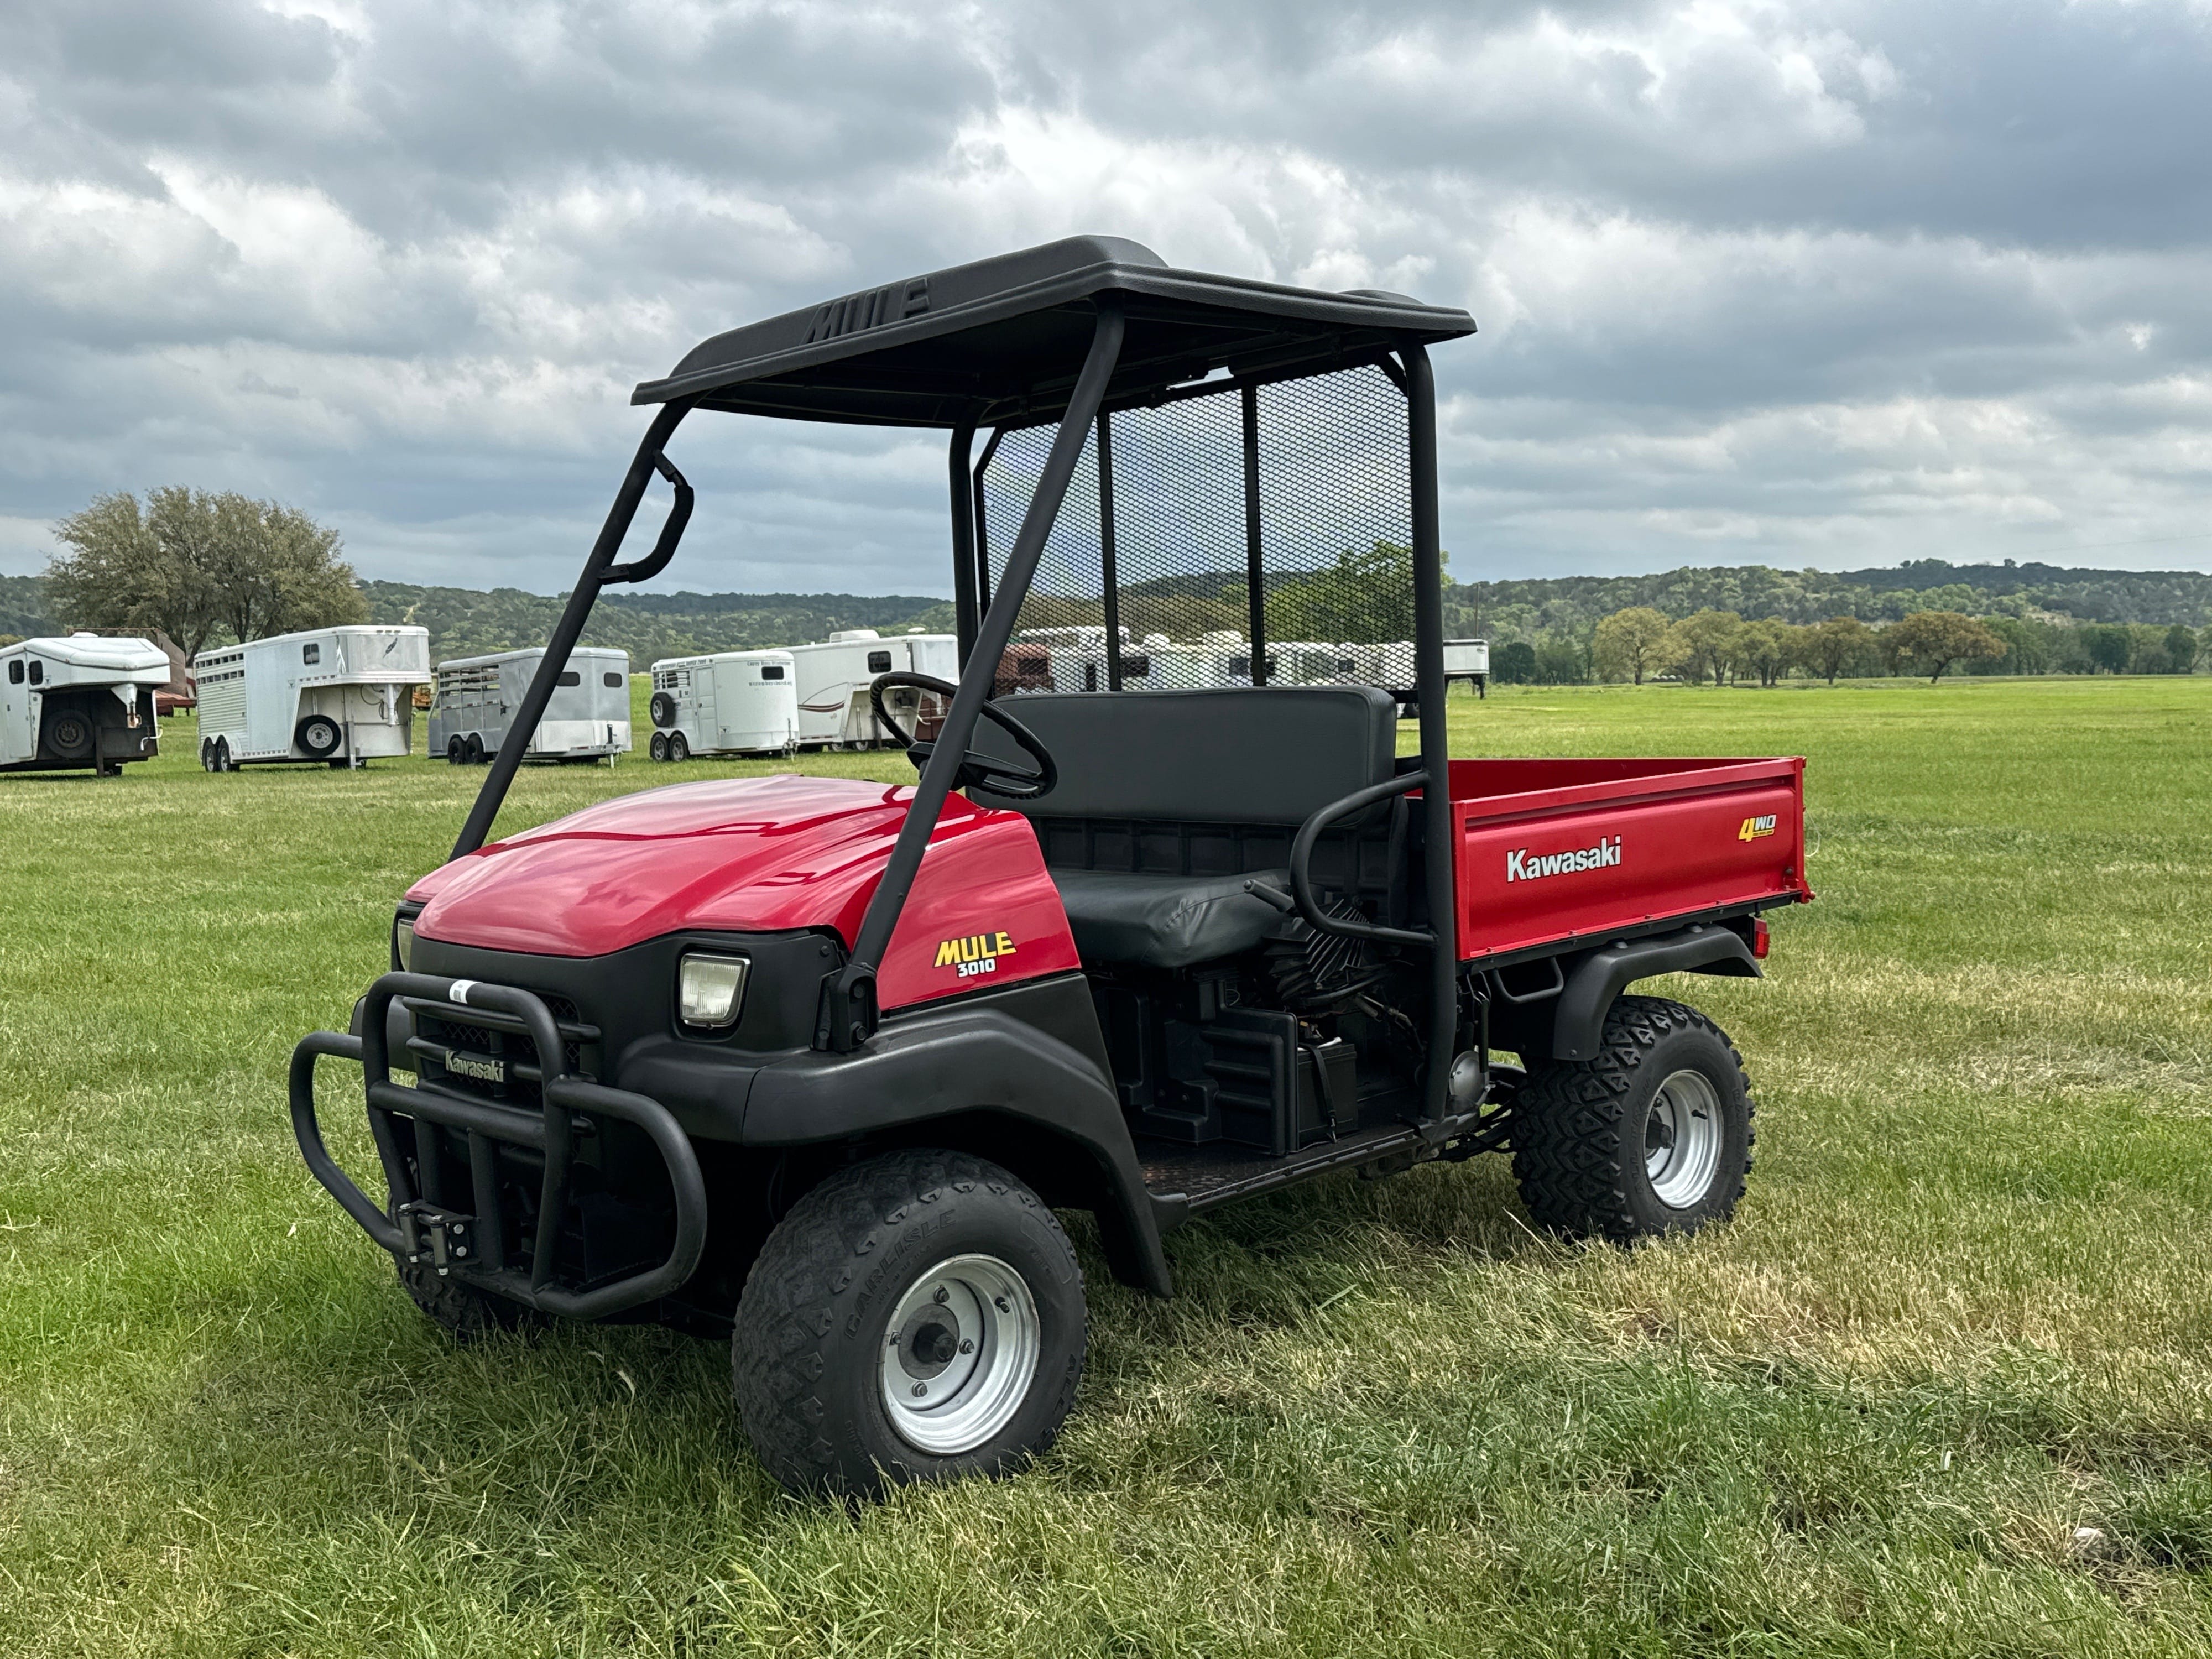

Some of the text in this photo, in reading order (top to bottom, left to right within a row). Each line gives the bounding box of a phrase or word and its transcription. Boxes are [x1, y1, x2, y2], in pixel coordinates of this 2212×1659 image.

[799, 276, 930, 346] MULE
[1738, 814, 1777, 842] 4WD
[1506, 835, 1622, 883] Kawasaki
[933, 931, 1018, 968] MULE
[957, 958, 997, 978] 3010
[445, 1050, 504, 1082] Kawasaki
[844, 1209, 956, 1339] CARLISLE
